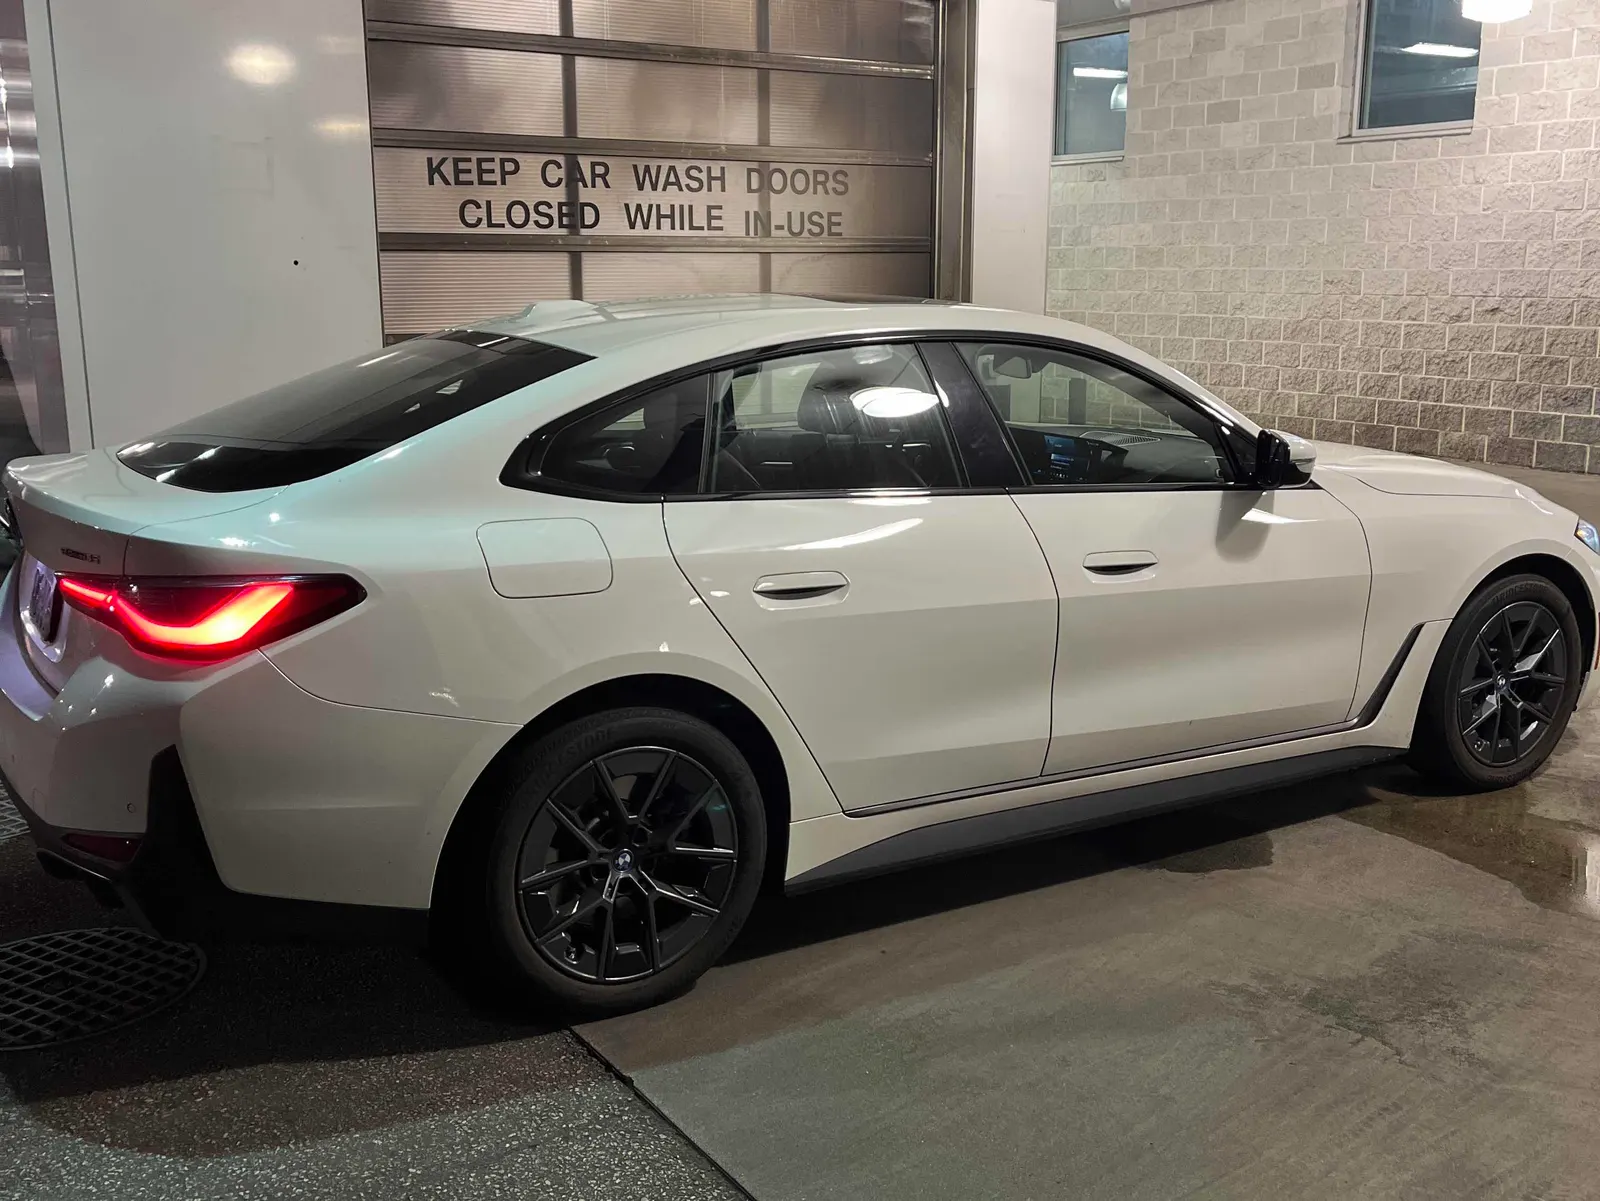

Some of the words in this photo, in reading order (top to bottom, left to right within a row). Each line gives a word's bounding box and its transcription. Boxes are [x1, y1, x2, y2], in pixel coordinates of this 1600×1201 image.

[426, 156, 520, 187] KEEP
[540, 159, 611, 189] CAR
[632, 164, 726, 193] WASH
[746, 167, 849, 196] DOORS
[458, 199, 600, 229] CLOSED
[624, 203, 724, 231] WHILE
[744, 210, 843, 237] IN-USE
